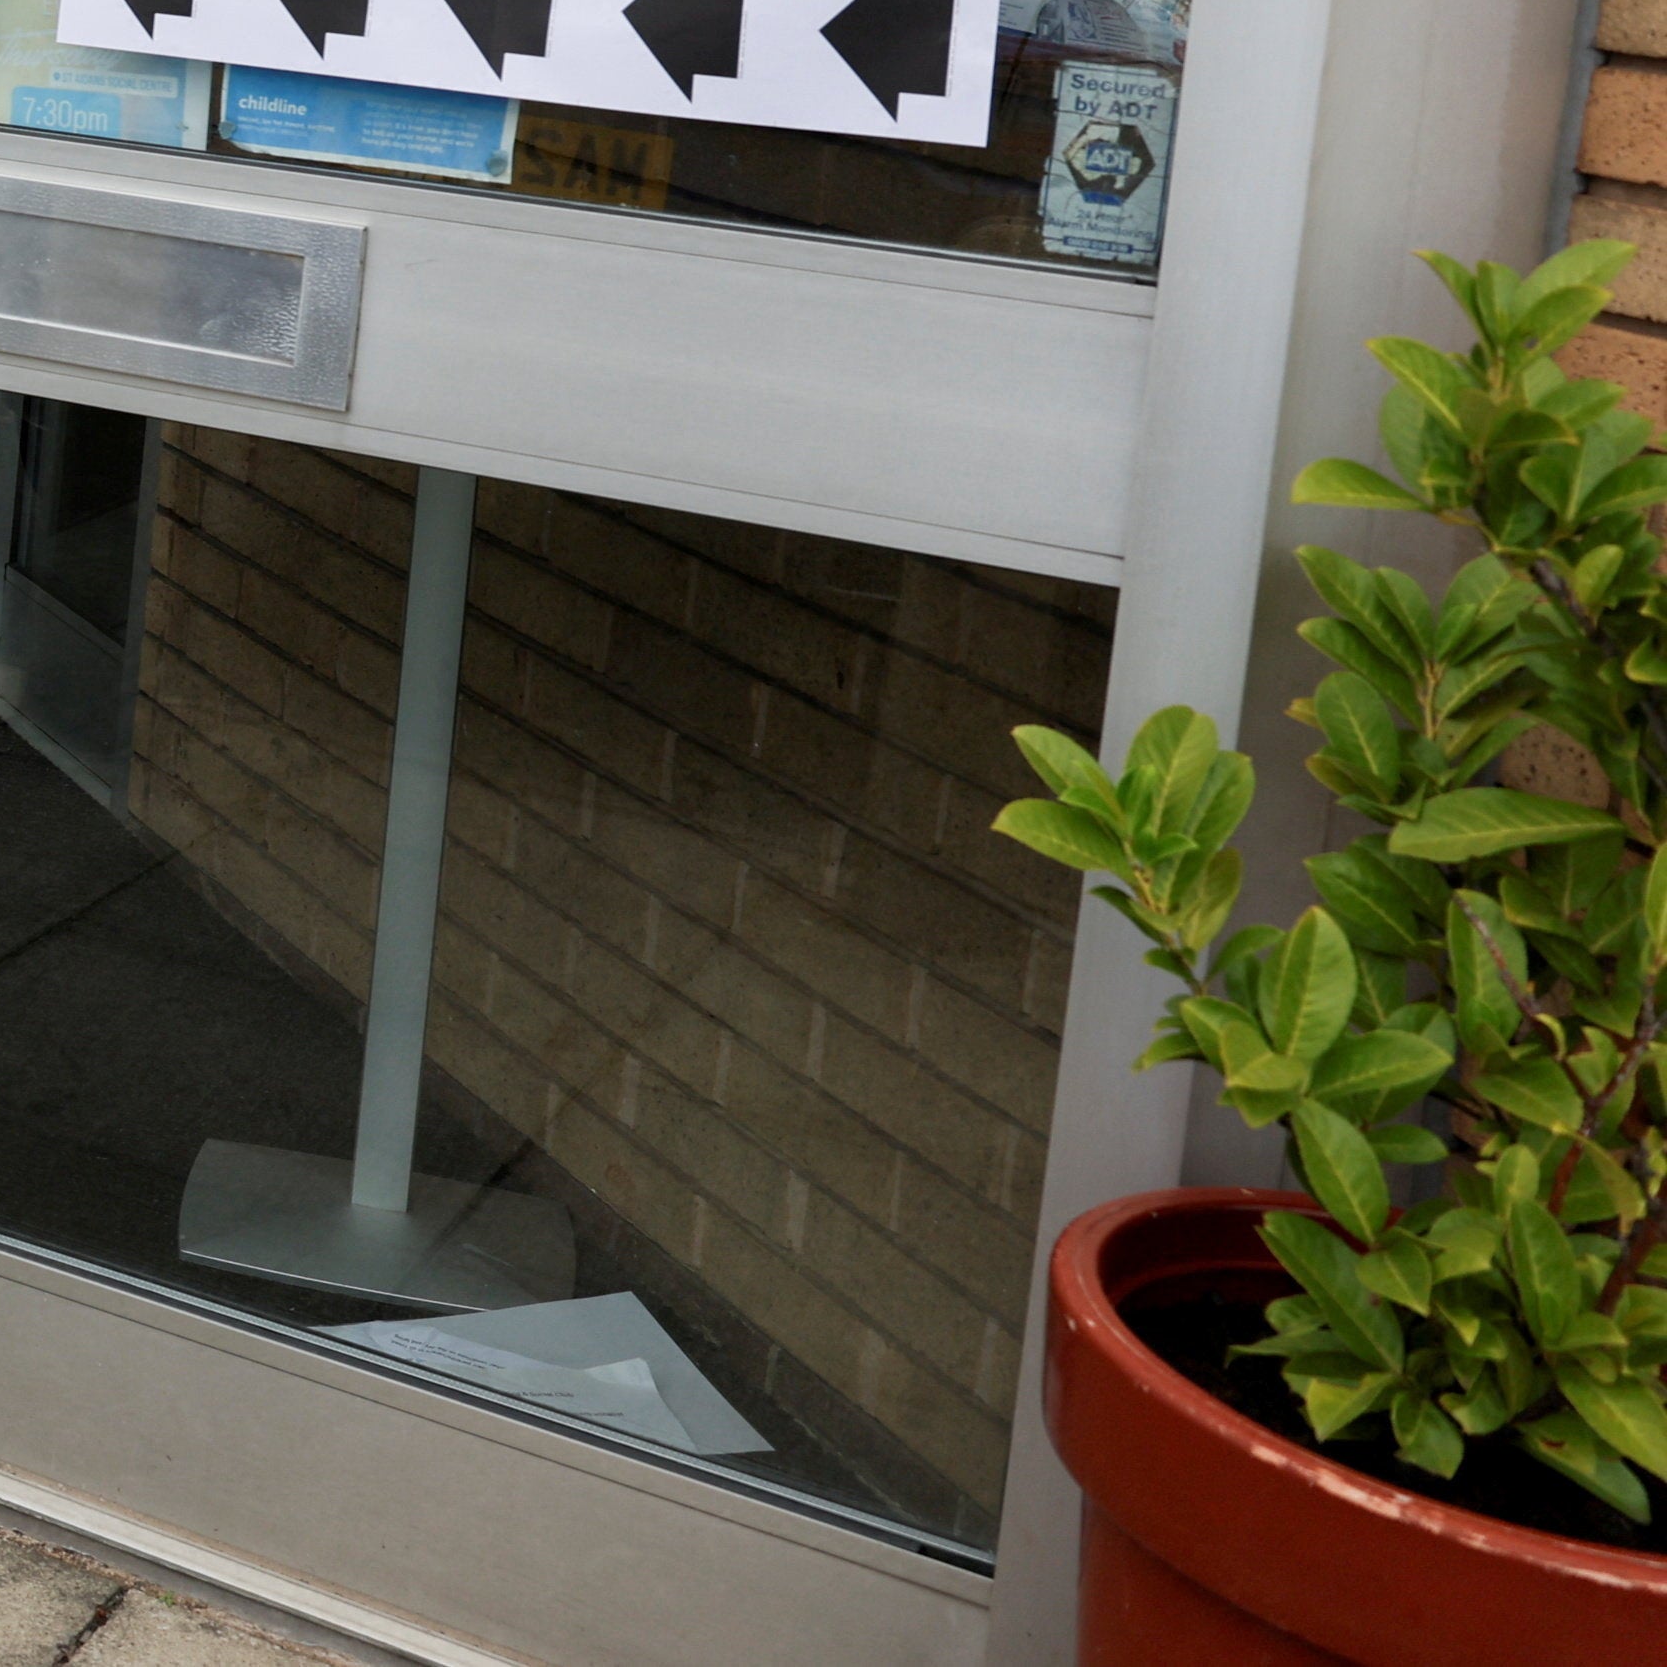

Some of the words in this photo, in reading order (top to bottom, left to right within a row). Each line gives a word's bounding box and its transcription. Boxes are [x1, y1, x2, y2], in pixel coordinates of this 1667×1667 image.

[1070, 74, 1166, 99] Secured
[22, 96, 108, 133] 7:30pm
[239, 95, 307, 116] childline
[1075, 96, 1101, 116] by
[1109, 100, 1157, 120] ADT
[1088, 148, 1132, 172] ADT
